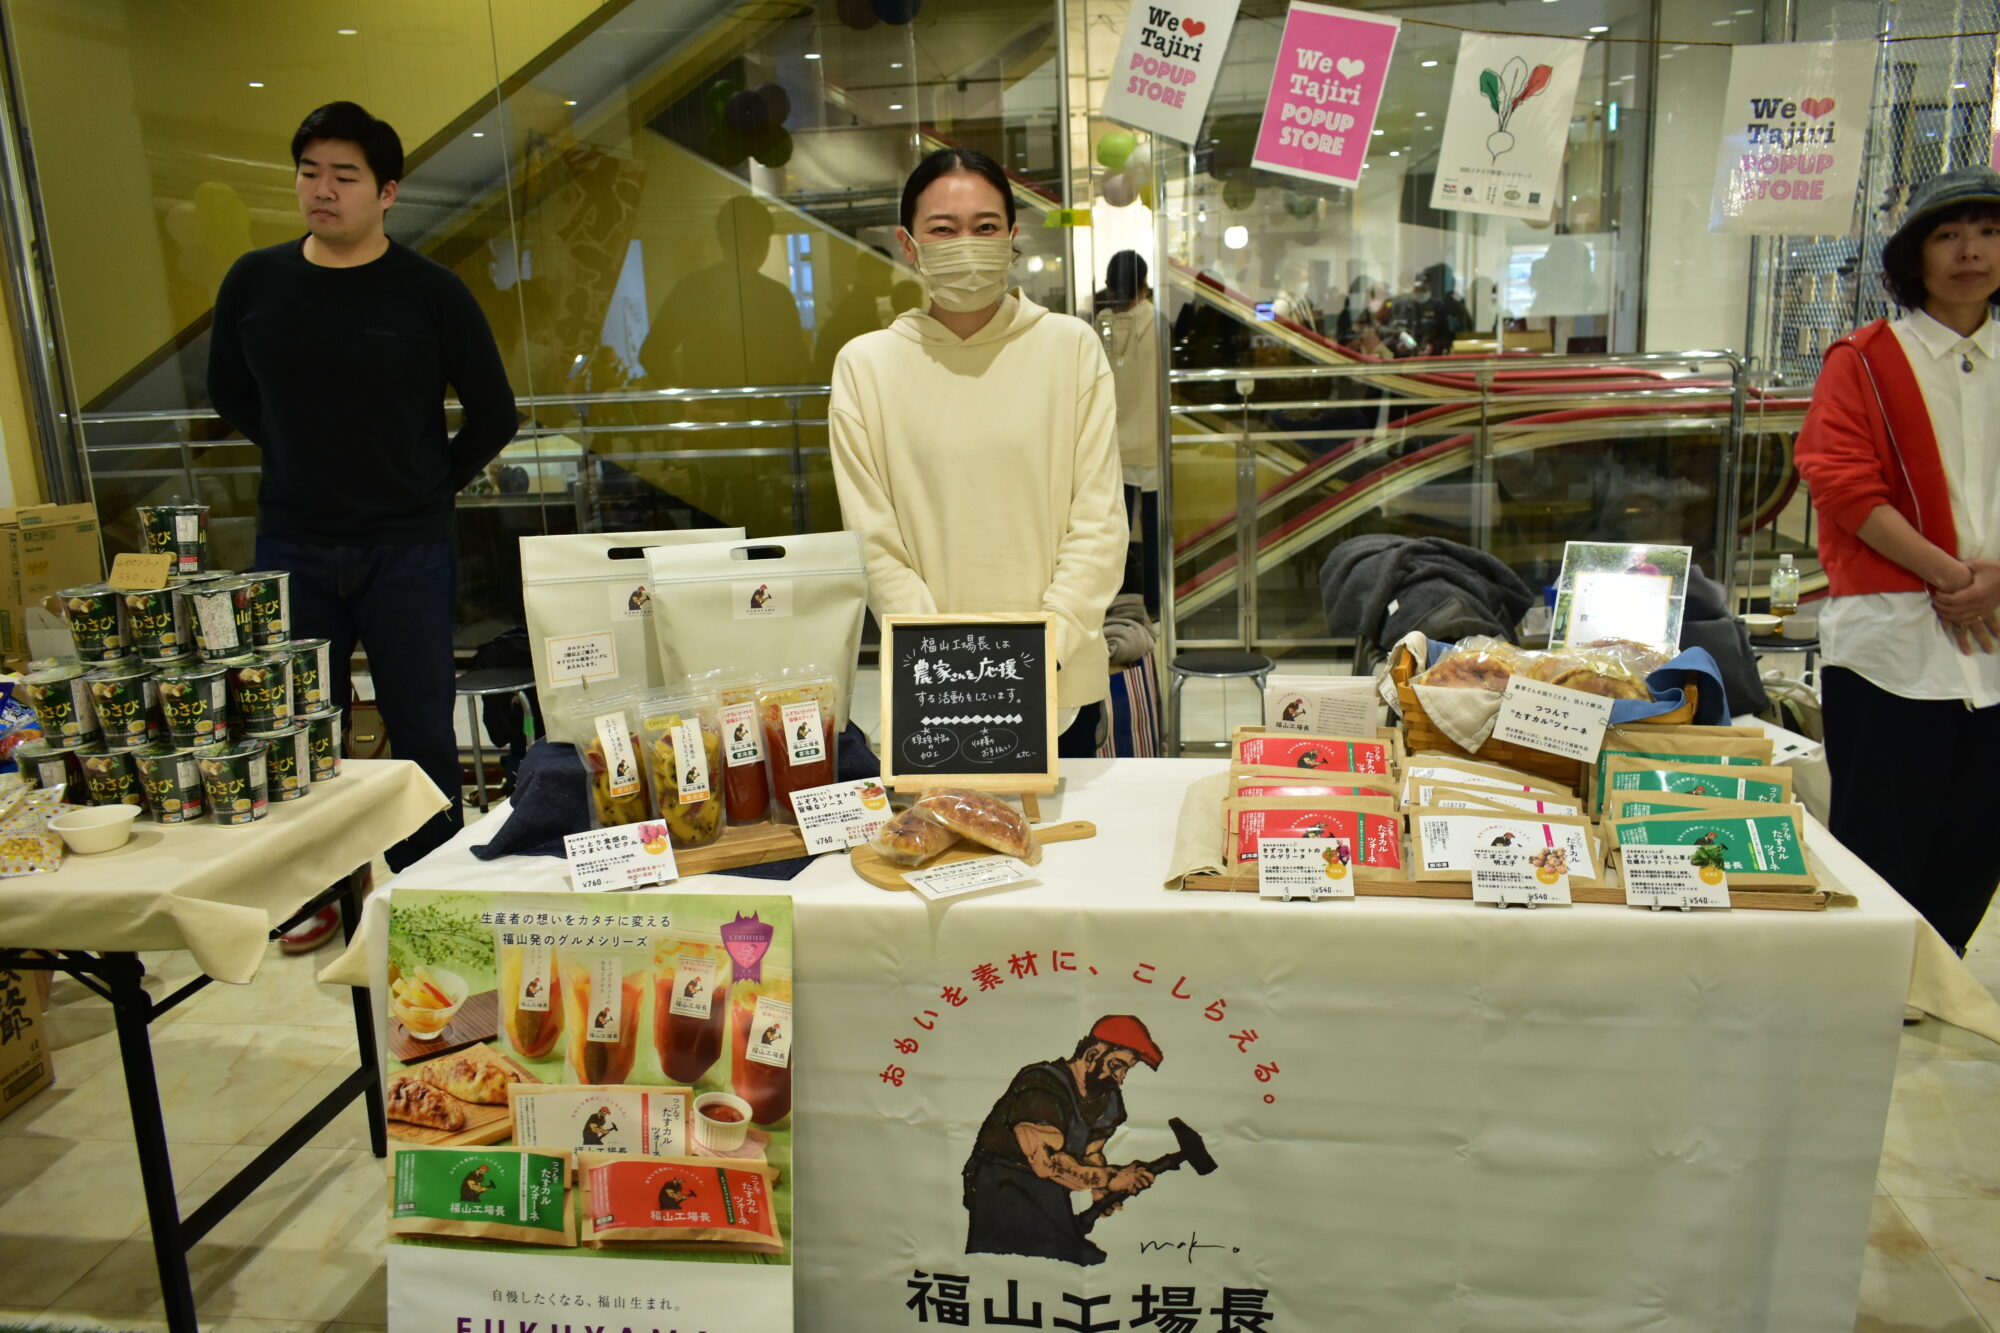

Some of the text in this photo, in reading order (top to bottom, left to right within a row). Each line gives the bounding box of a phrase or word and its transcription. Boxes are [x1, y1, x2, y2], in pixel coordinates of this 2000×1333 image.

[1149, 6, 1179, 31] We
[1140, 27, 1203, 62] Tajiri
[1130, 52, 1196, 87] POPUP
[1296, 47, 1333, 73] We
[1126, 75, 1187, 109] STORE
[1290, 73, 1362, 105] Tajiri
[1281, 102, 1355, 132] POPUP
[1750, 97, 1797, 119] We
[1279, 126, 1345, 156] STORE
[1747, 121, 1836, 150] Tajiri
[1742, 153, 1834, 175] POPUP
[920, 634, 1011, 653] 福山工場長は
[913, 657, 1025, 685] 農家さんを応援
[915, 688, 1022, 706] する活動をしています。
[1535, 705, 1570, 719] つつんで
[730, 741, 757, 751] 福山工場長
[793, 741, 819, 750] 福山工場長
[613, 776, 636, 786] 福山工場長
[682, 784, 706, 793] 福山工場長
[796, 791, 856, 806] ふぞろいトマトの
[1768, 787, 1776, 803] つつん
[798, 800, 844, 813] 旨味なソース
[570, 835, 628, 851] しっとり食感の
[571, 838, 646, 857] さつまいもピクルス
[816, 836, 833, 845] ¥760
[1377, 824, 1389, 852] たすカル
[1772, 829, 1789, 860] たすカル
[1367, 837, 1378, 863] ツォーネ
[1566, 837, 1580, 863] たすカル
[1764, 844, 1780, 870] ツォーネ
[583, 879, 602, 888] ¥760
[481, 912, 671, 928] 生産者の想いをカタチに変える
[502, 932, 648, 948] 福山発のグルメシリーズ
[675, 1001, 707, 1012] 福山工場長
[751, 1046, 786, 1061] 福山工場長
[662, 1107, 673, 1145] たすカル
[541, 1168, 552, 1205] たすカル
[529, 1184, 540, 1222] ツォーネ
[741, 1182, 758, 1214] たすカル
[450, 1202, 506, 1217] 福山工場長
[651, 1210, 712, 1223] 福山工場長
[491, 1289, 681, 1312] 自慢したくなる、福山生まれ。
[905, 1269, 1275, 1333] 福山工場長
